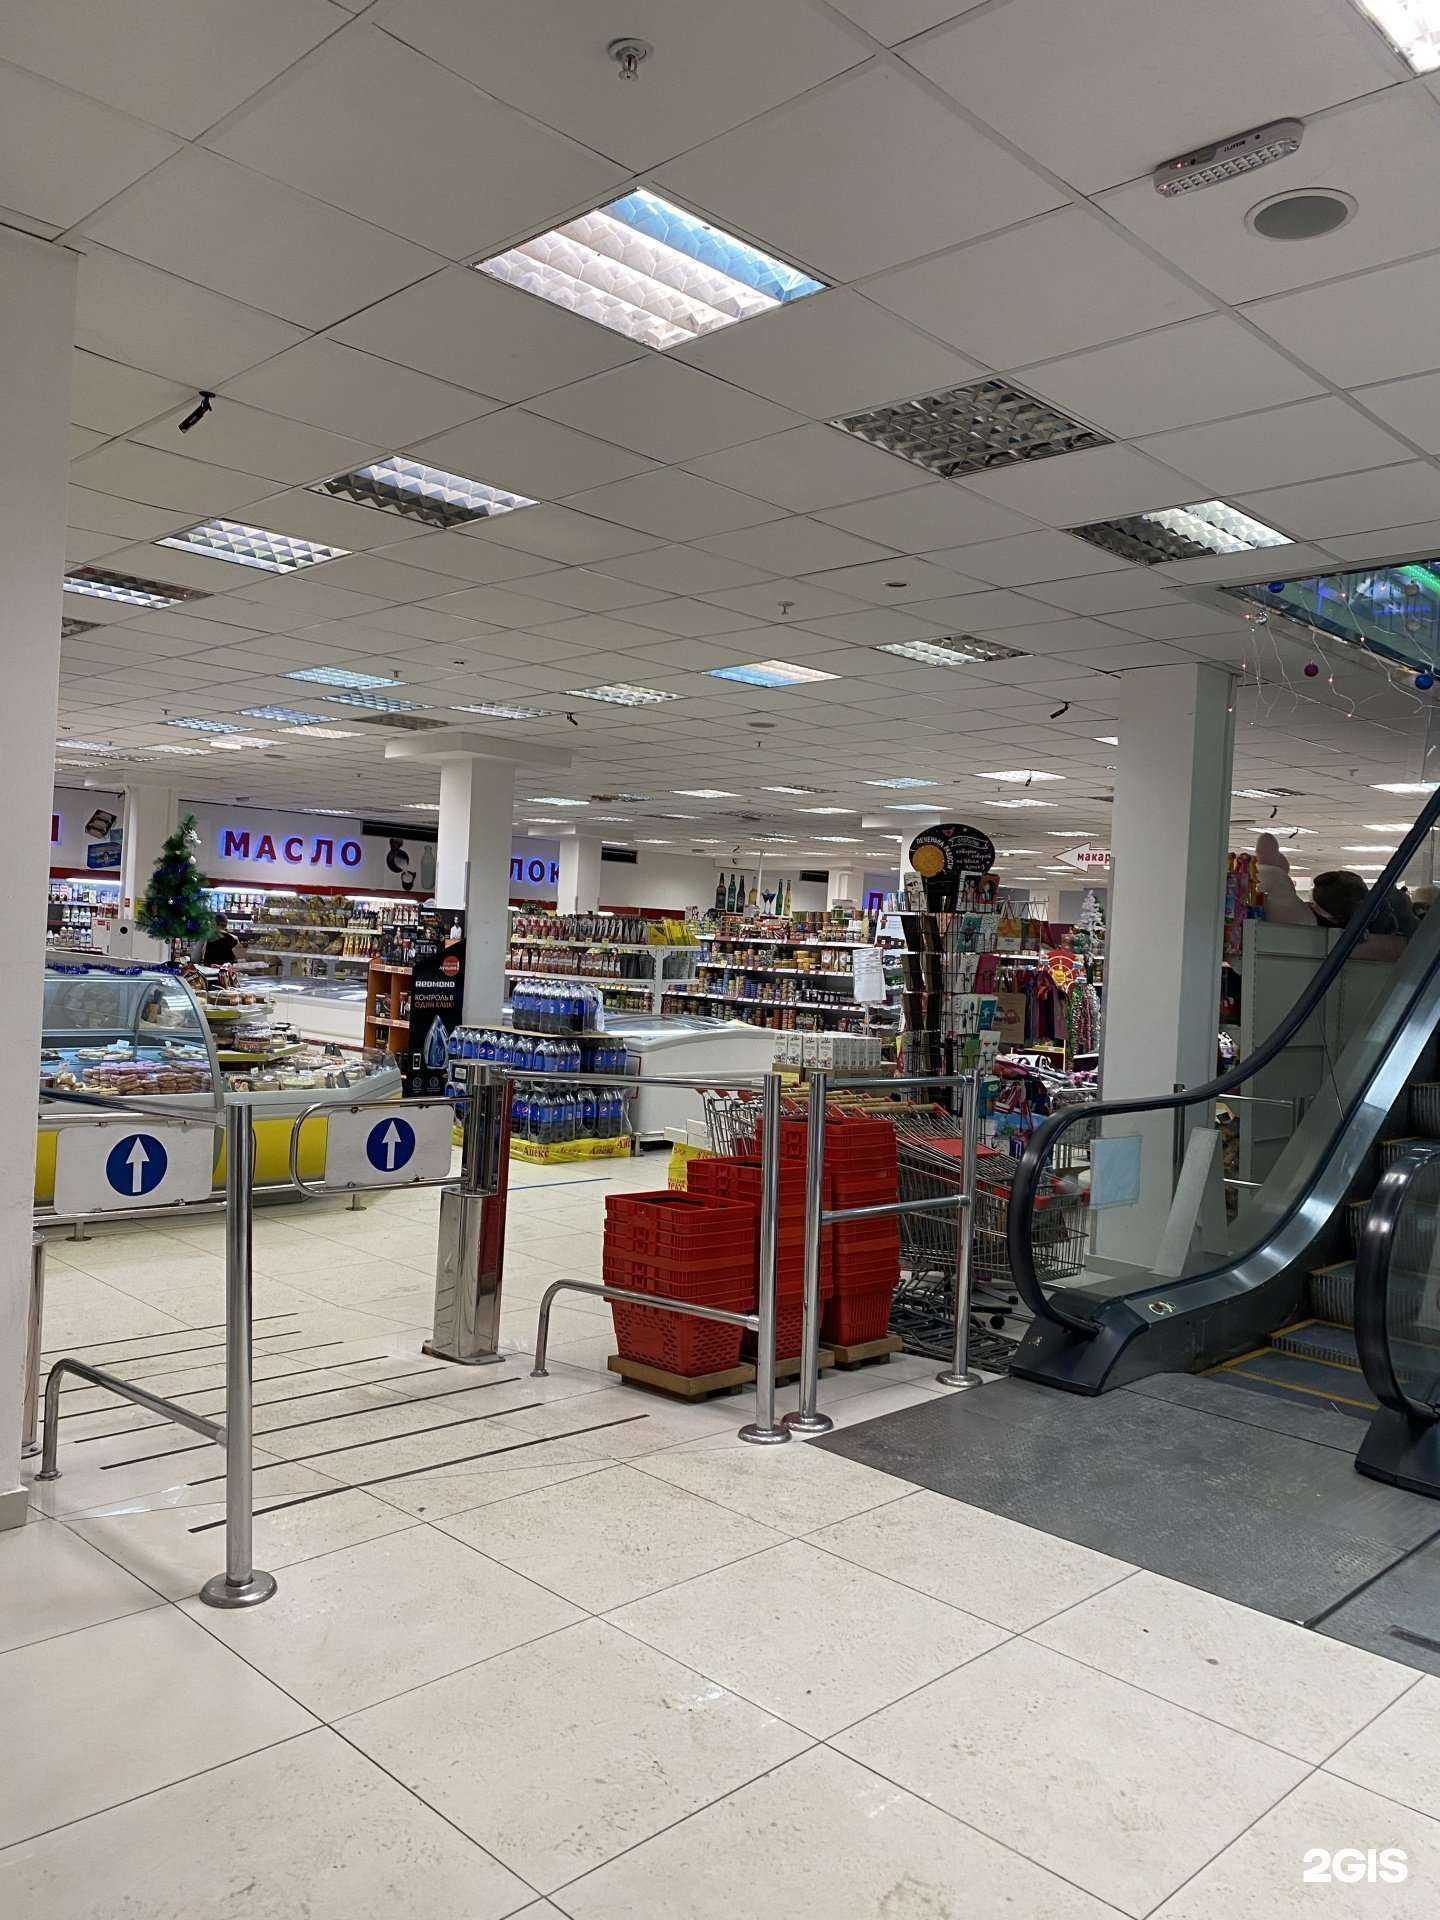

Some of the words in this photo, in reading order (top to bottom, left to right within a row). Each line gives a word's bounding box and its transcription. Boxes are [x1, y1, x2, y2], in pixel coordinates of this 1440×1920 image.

[224, 830, 362, 866] МАСЛО
[1077, 853, 1110, 864] макар
[415, 980, 456, 988] REDMOND
